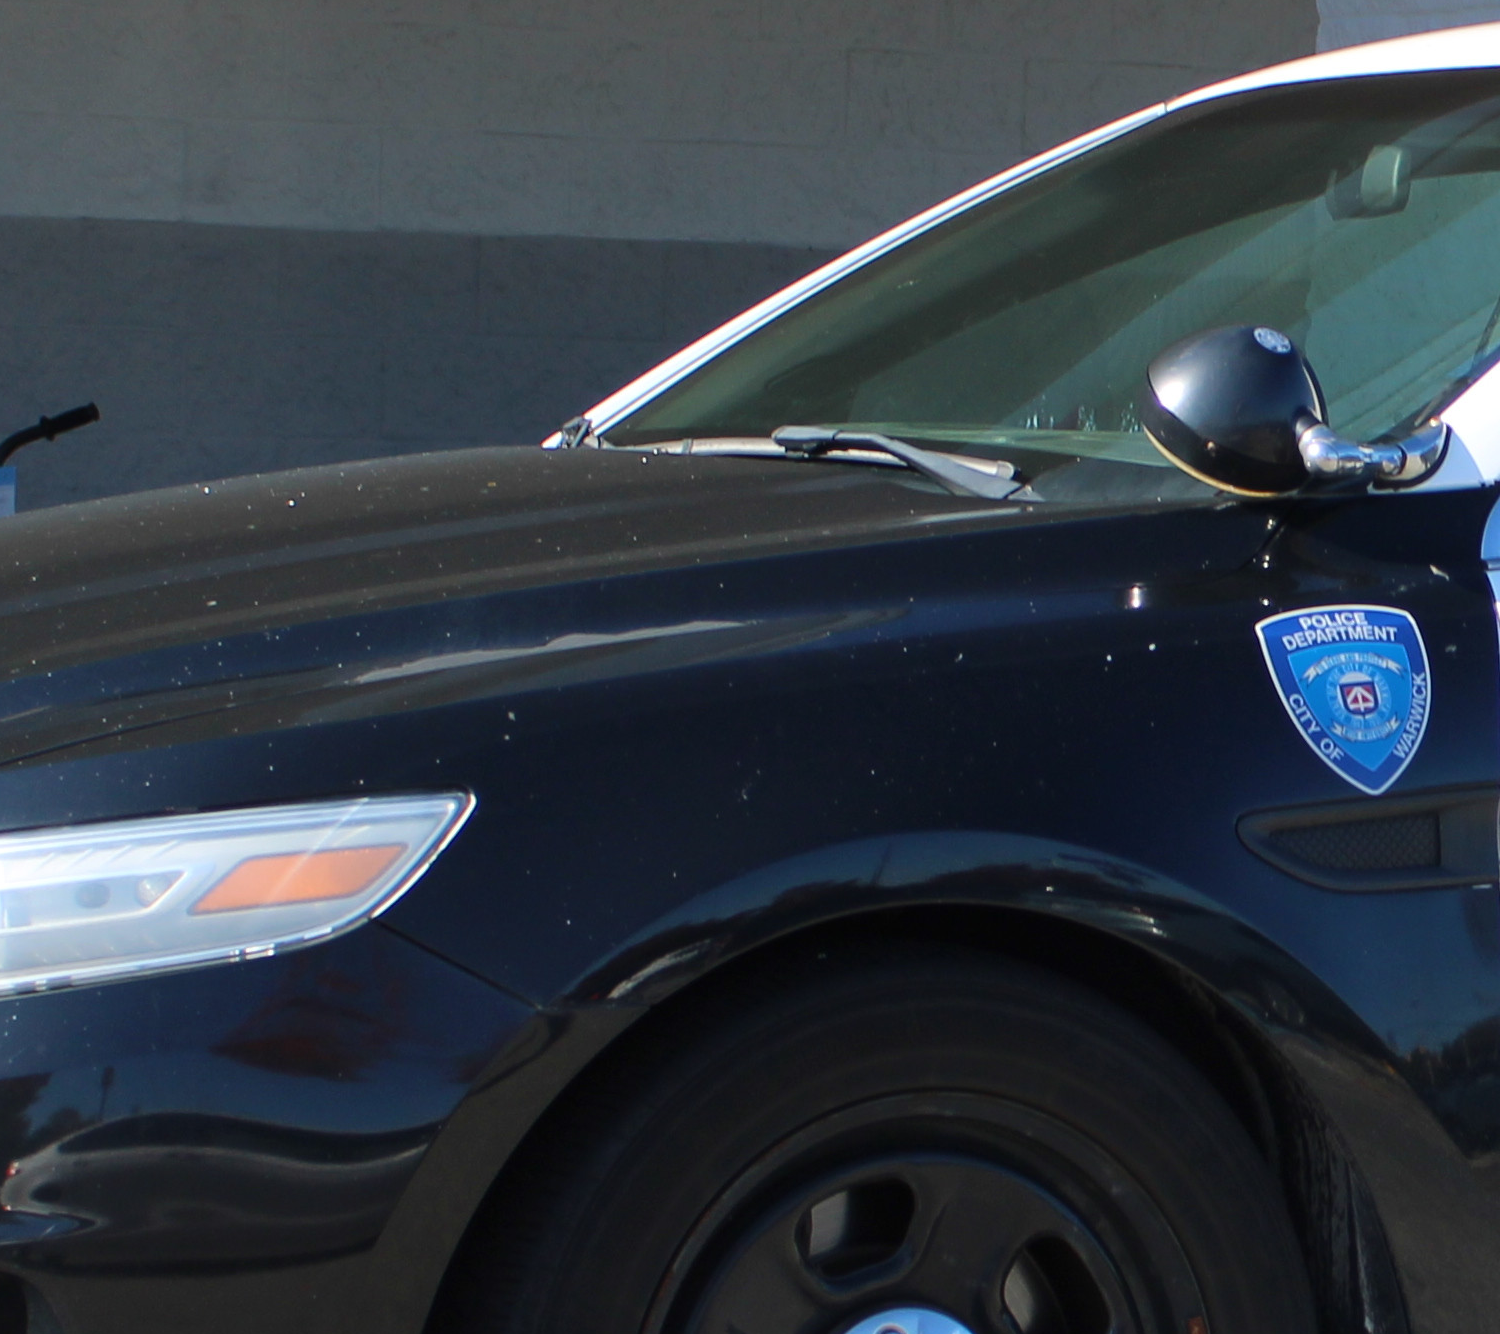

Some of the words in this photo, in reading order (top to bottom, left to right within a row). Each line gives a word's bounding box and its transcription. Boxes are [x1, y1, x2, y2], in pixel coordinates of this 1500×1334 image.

[1281, 625, 1399, 652] DEPARTMENT
[1297, 612, 1368, 629] POLICE
[1288, 692, 1322, 736] CITY
[1319, 736, 1346, 763] OF
[1391, 671, 1427, 761] WARWICK
